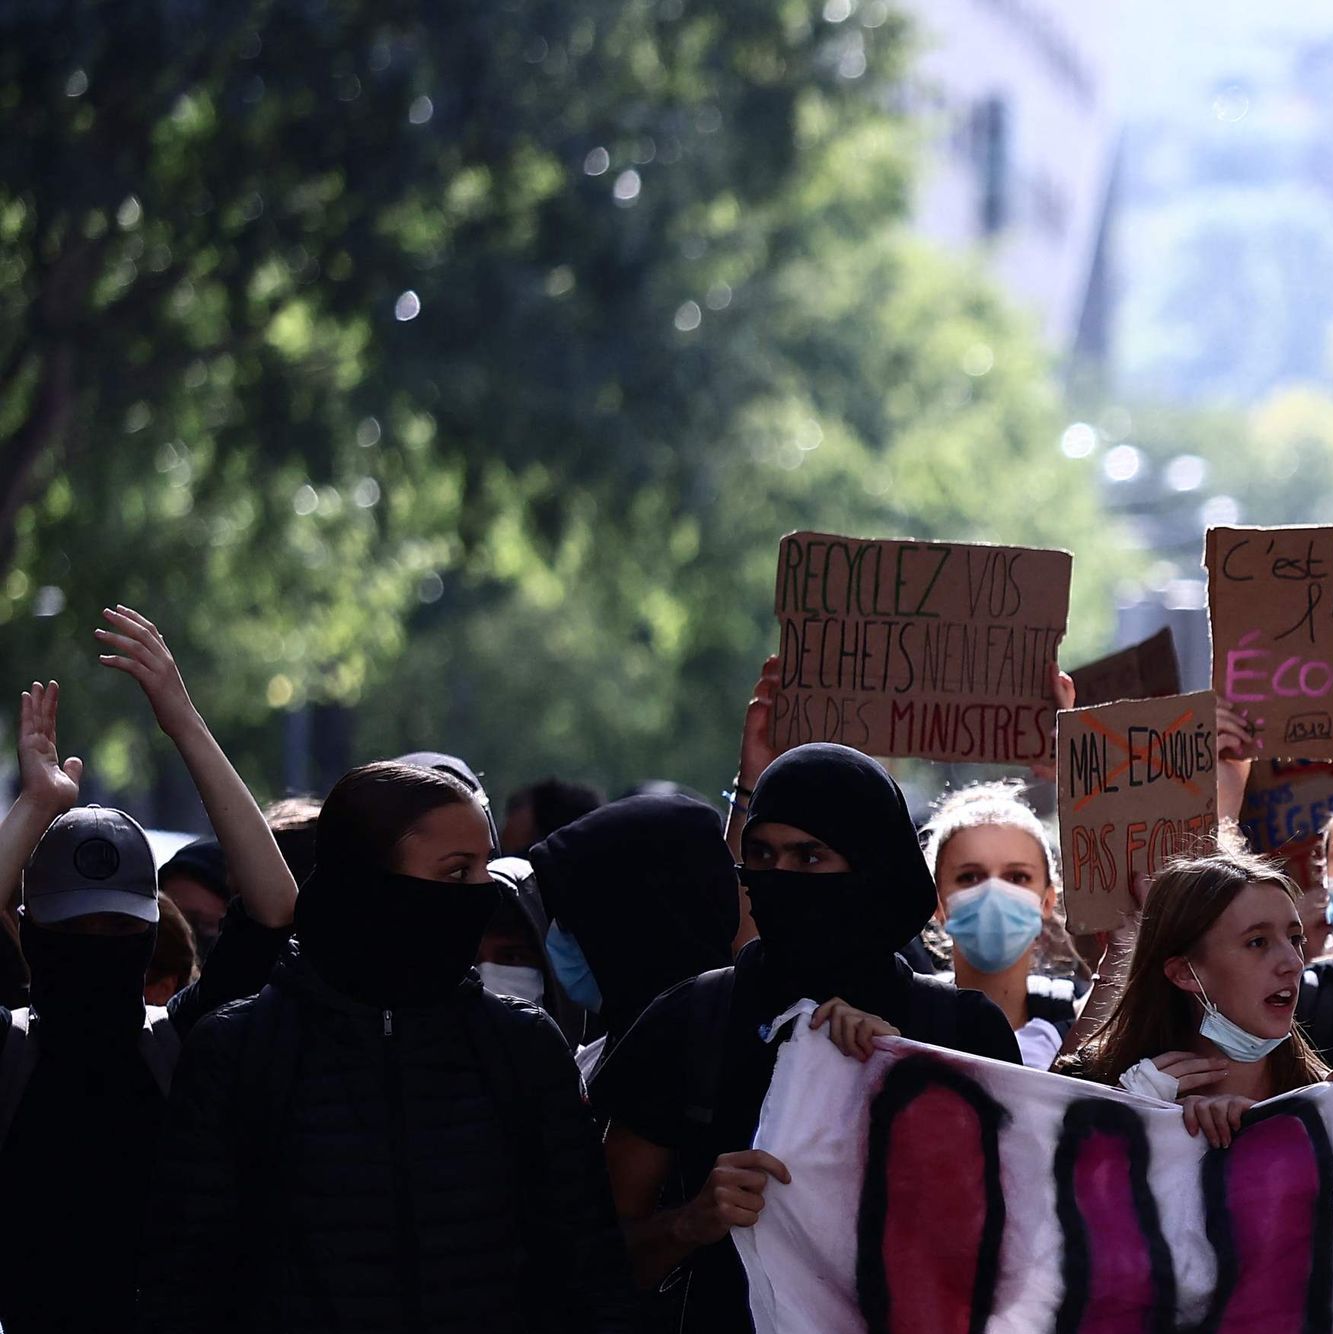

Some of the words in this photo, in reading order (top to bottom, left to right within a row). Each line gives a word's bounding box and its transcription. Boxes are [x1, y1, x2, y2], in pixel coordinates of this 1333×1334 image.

[781, 538, 952, 618] RECYCLEZ
[967, 551, 1021, 618] VOS
[1222, 540, 1328, 582] C'est
[772, 692, 814, 748] PAS
[824, 696, 872, 746] DES
[1069, 732, 1120, 799] MAL
[1071, 822, 1118, 895] PAS
